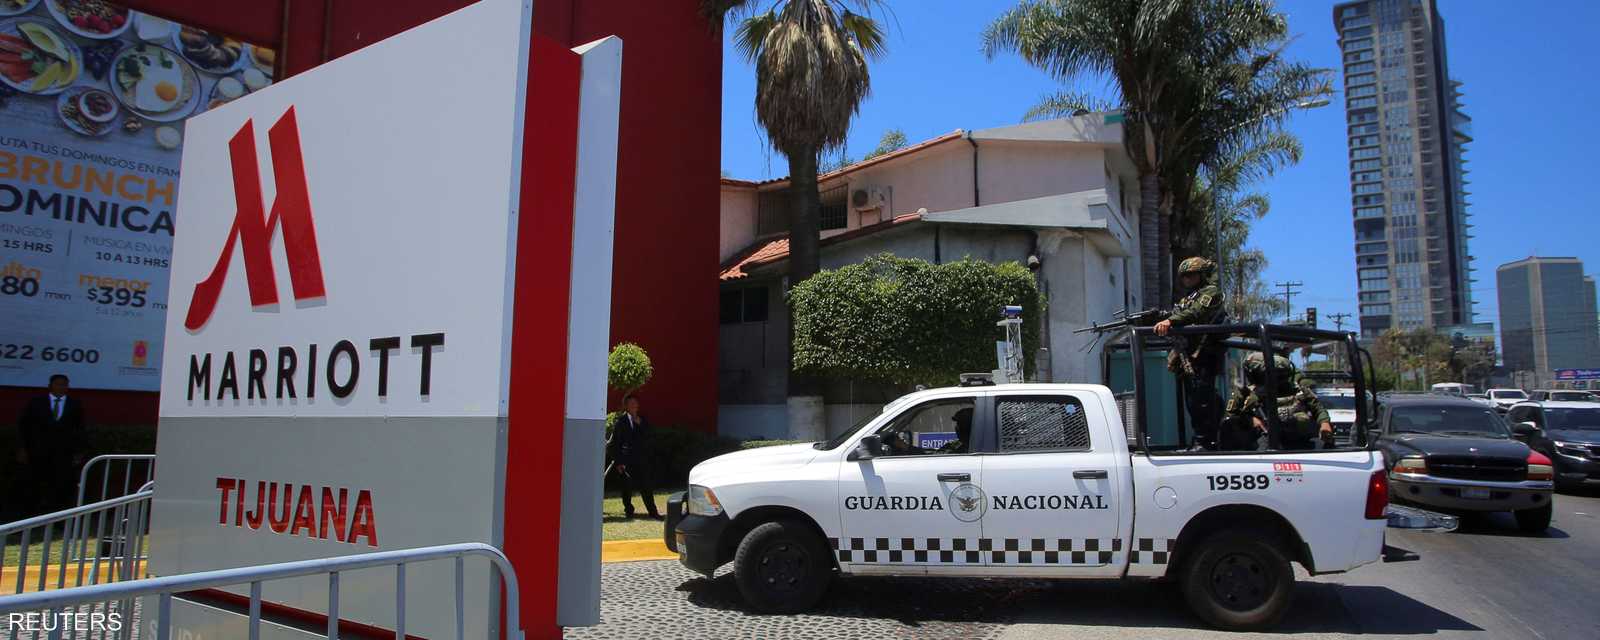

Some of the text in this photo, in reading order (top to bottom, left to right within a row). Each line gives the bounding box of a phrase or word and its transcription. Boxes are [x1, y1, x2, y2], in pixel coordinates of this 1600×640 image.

[32, 141, 58, 155] TUS
[62, 148, 136, 169] DOMINGOS
[137, 163, 156, 174] EN
[3, 239, 54, 253] 15 HRS
[96, 251, 169, 268] 10 A 13 HRS
[79, 274, 152, 292] menor
[87, 286, 146, 308] $395
[40, 346, 100, 364] 6600
[187, 332, 445, 400] MARRIOTT
[1206, 475, 1269, 491] 19589
[844, 494, 1108, 511] GUARDIA NACIONAL
[216, 477, 379, 548] TIJUANA
